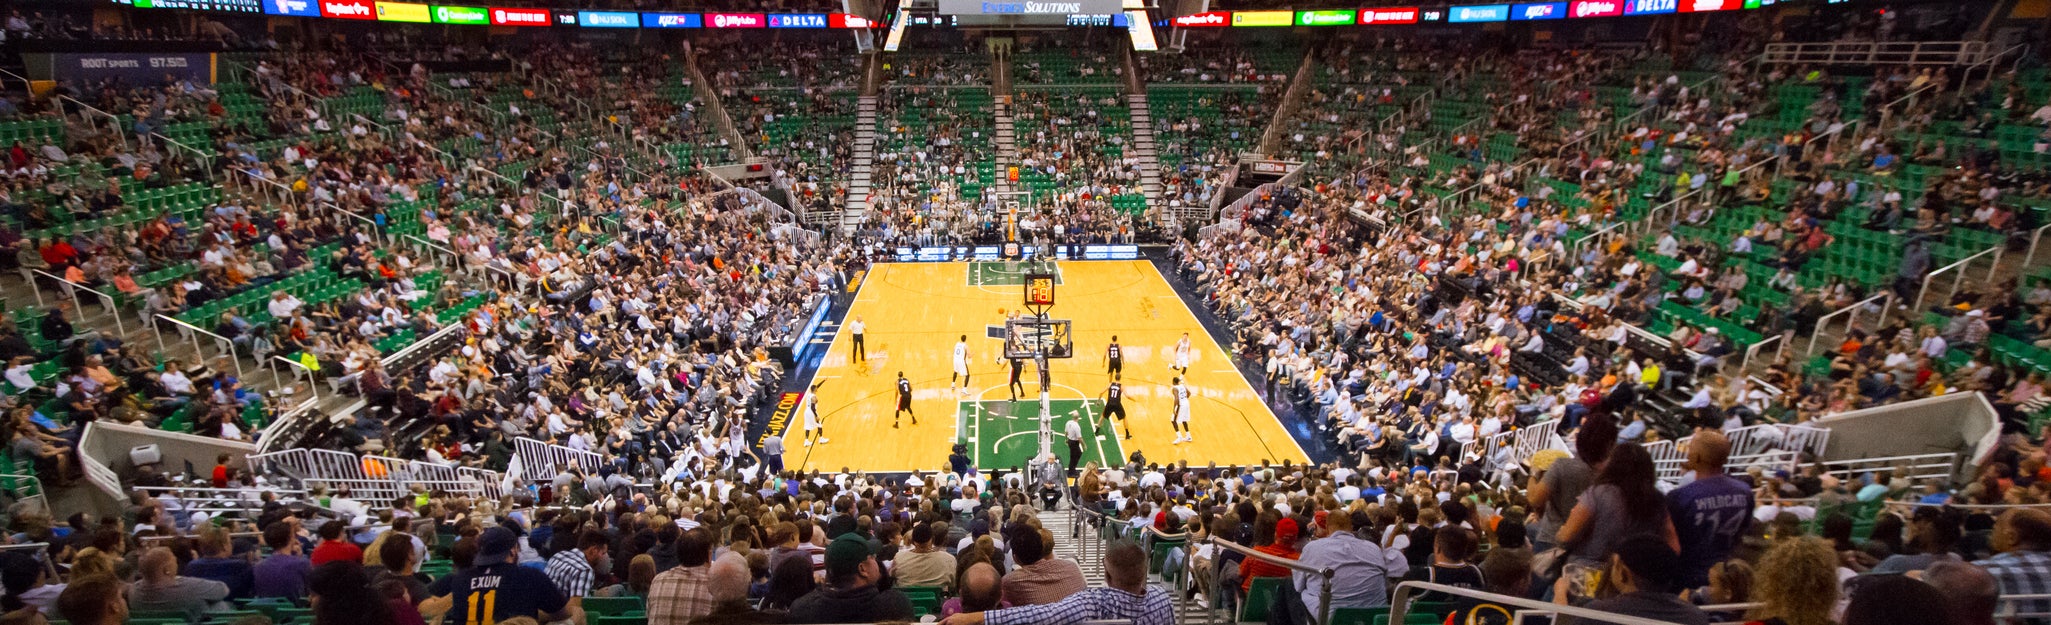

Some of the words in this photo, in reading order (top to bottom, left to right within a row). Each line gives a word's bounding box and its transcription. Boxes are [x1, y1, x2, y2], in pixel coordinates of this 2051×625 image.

[1637, 0, 1676, 11] DELTA
[783, 16, 825, 26] DELTA
[81, 58, 107, 68] ROOT
[109, 60, 139, 68] SPORTS
[1111, 389, 1118, 398] 11
[1694, 494, 1748, 511] WILDCATS
[470, 575, 502, 590] EXUM
[466, 589, 497, 625] 11
